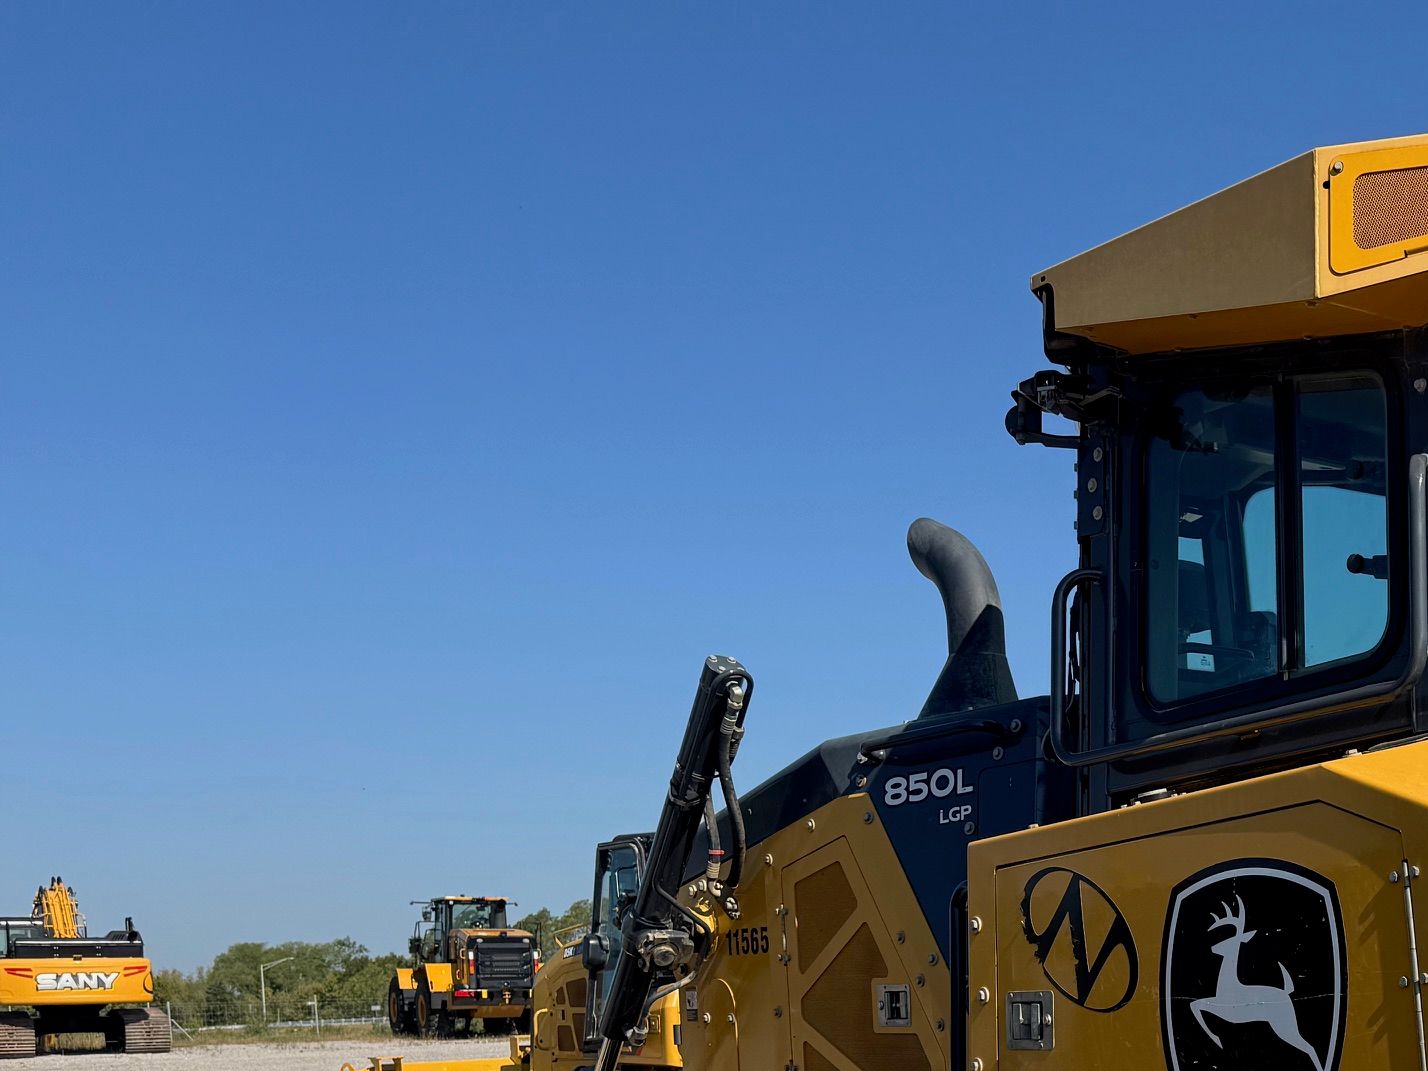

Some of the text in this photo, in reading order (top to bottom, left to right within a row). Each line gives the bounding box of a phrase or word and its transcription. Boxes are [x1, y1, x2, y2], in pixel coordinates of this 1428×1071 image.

[884, 768, 974, 806] 850L
[939, 804, 972, 824] LGP
[726, 926, 769, 955] 11565
[35, 971, 120, 991] SANY
